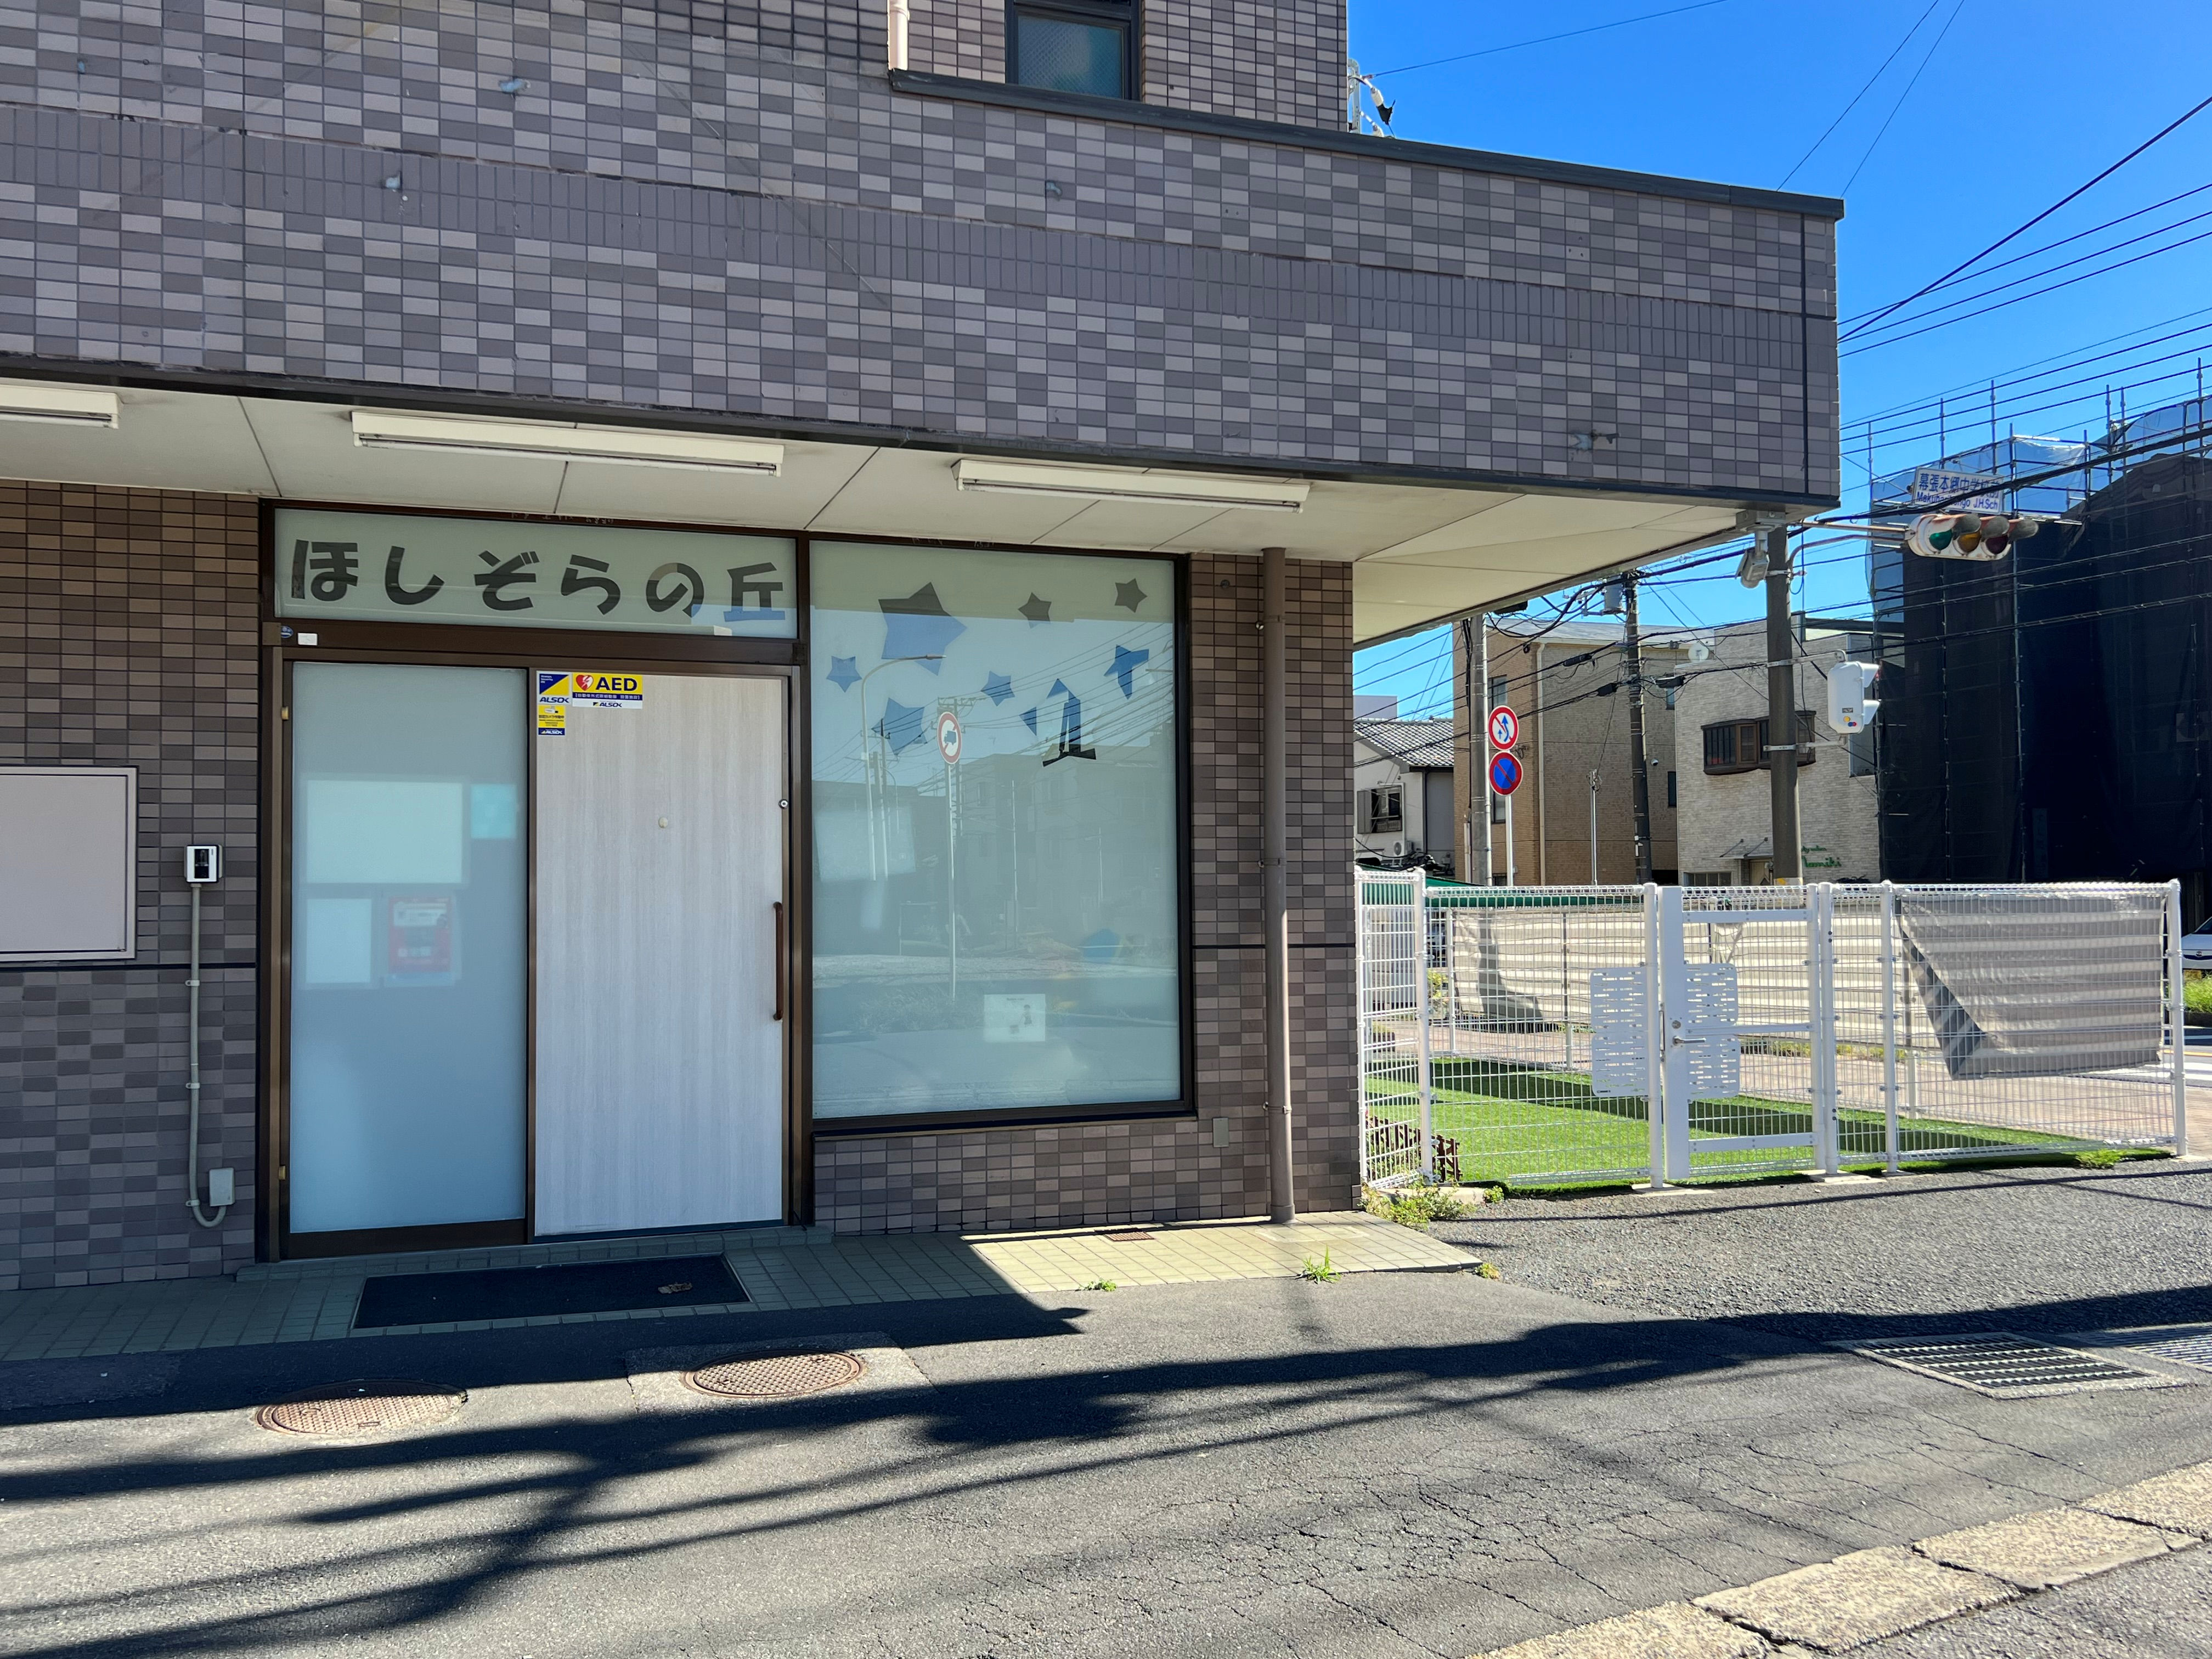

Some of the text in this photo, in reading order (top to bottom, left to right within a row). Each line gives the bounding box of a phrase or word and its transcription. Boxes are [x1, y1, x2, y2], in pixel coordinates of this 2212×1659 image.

[291, 538, 785, 622] ほしぞらの丘
[595, 677, 637, 691] AED
